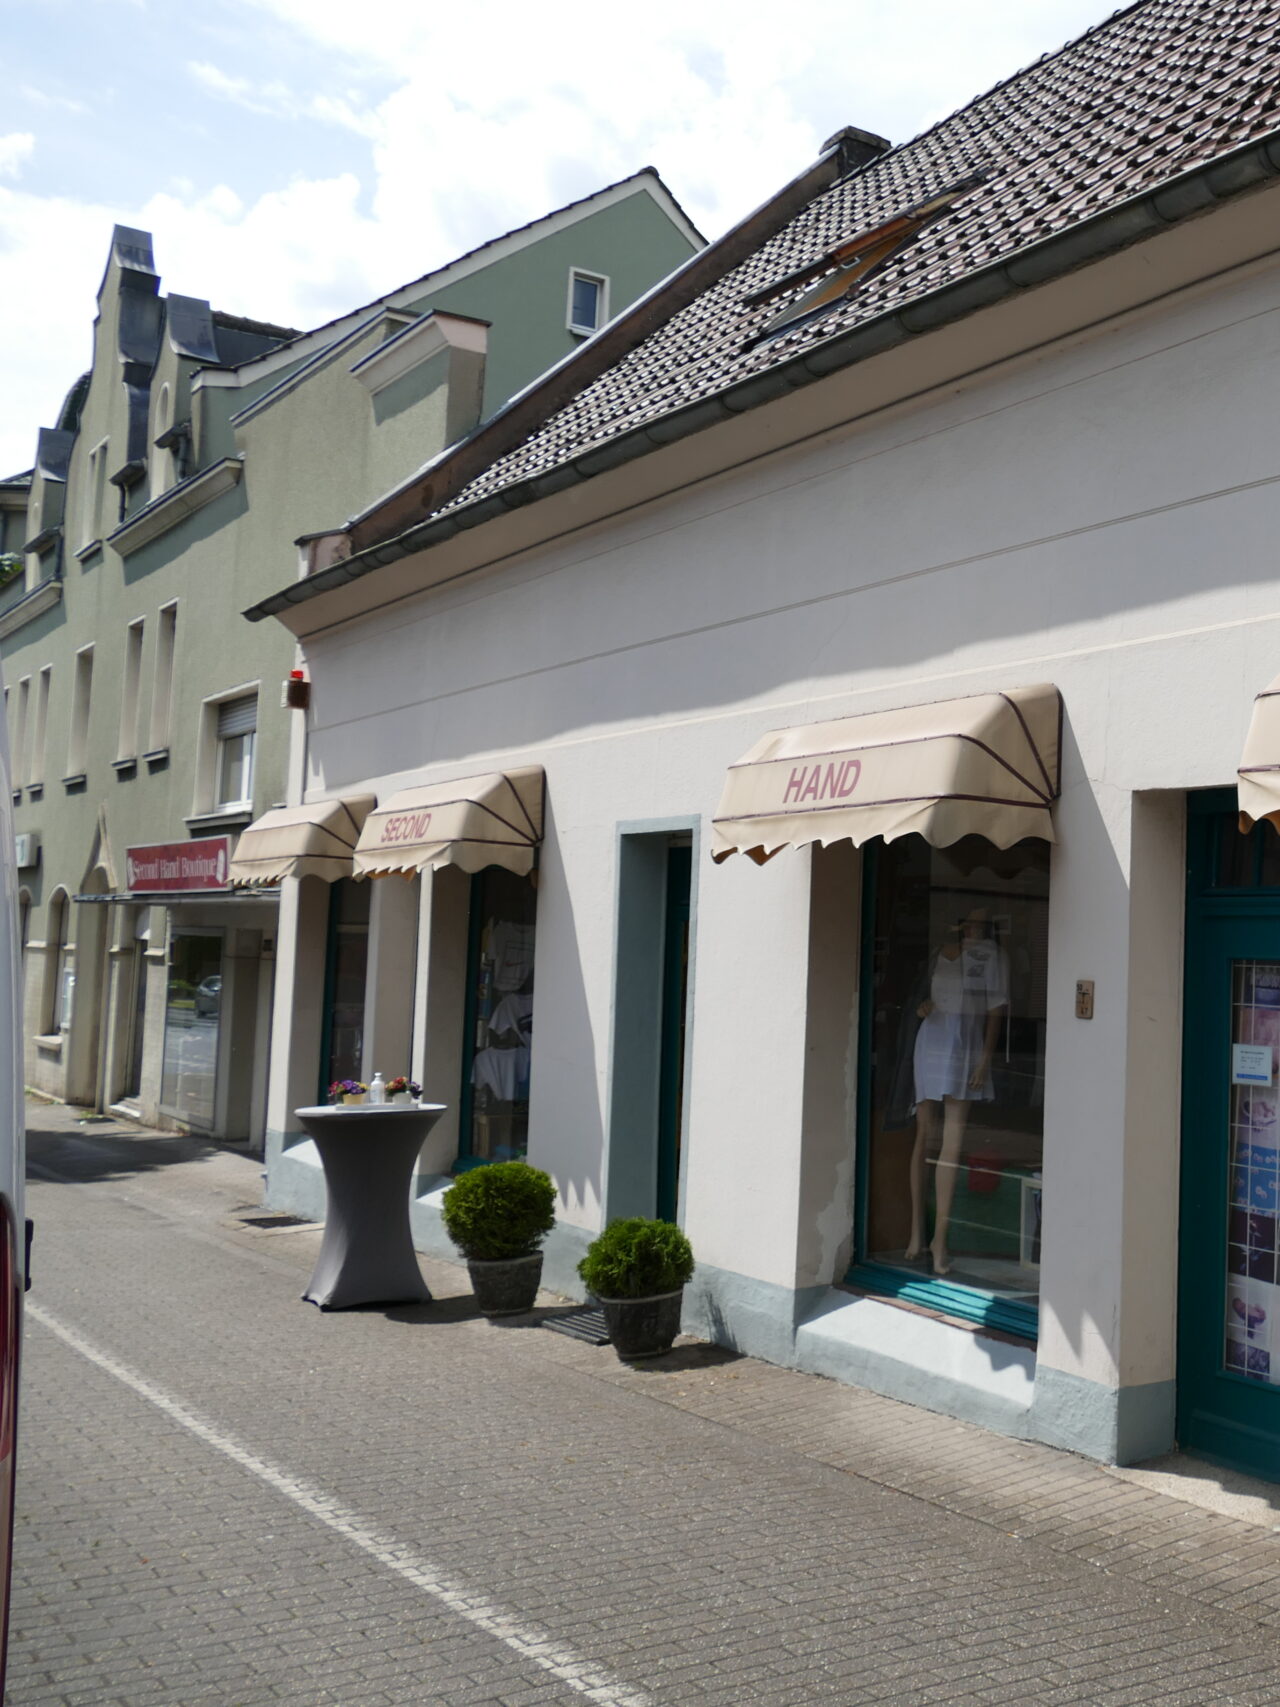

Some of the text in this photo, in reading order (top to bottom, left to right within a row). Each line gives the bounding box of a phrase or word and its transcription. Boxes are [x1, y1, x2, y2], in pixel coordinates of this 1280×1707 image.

[782, 759, 862, 804] HAND
[380, 812, 432, 843] SECOND
[133, 854, 216, 882] Second Hand Boutique
